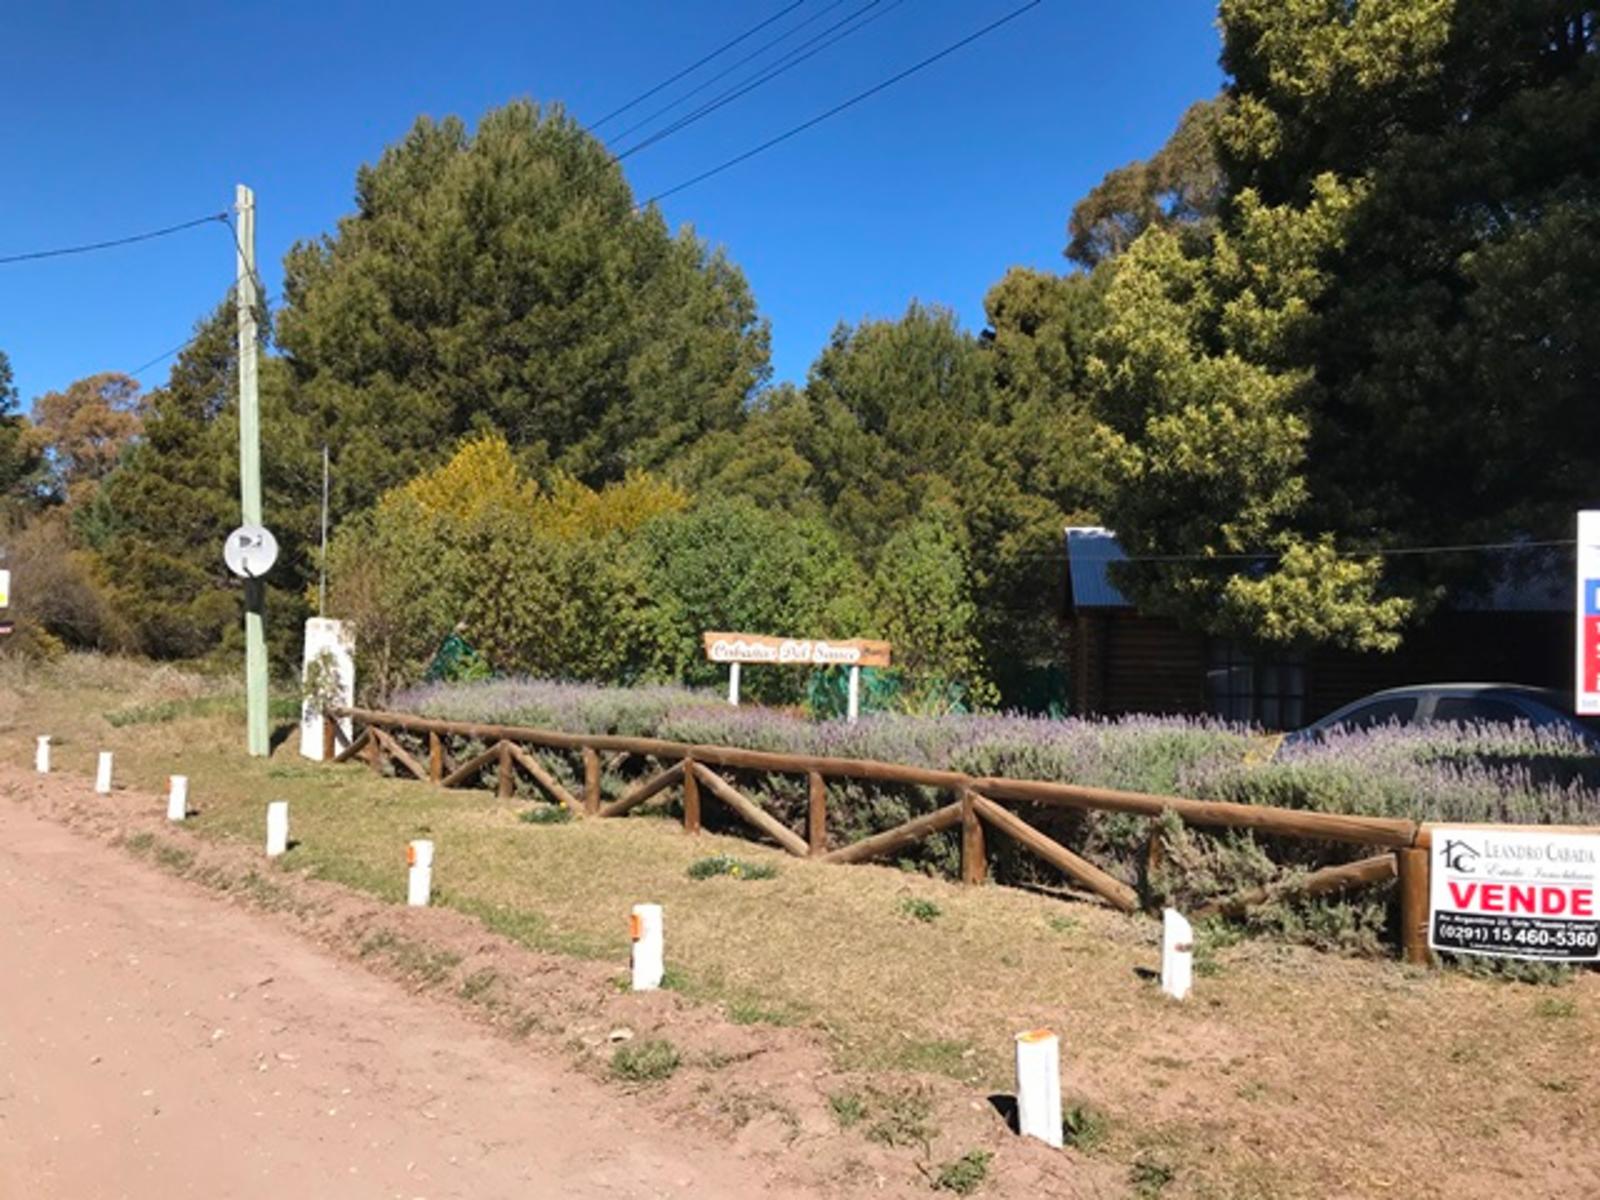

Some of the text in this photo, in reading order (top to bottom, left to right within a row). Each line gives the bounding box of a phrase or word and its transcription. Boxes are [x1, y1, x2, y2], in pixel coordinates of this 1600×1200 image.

[1484, 840, 1543, 860] LEANDRO
[1448, 882, 1593, 915] VENDE
[1439, 924, 1489, 941] (0291)
[1492, 927, 1513, 942] 15
[1515, 929, 1598, 947] 460-5360
